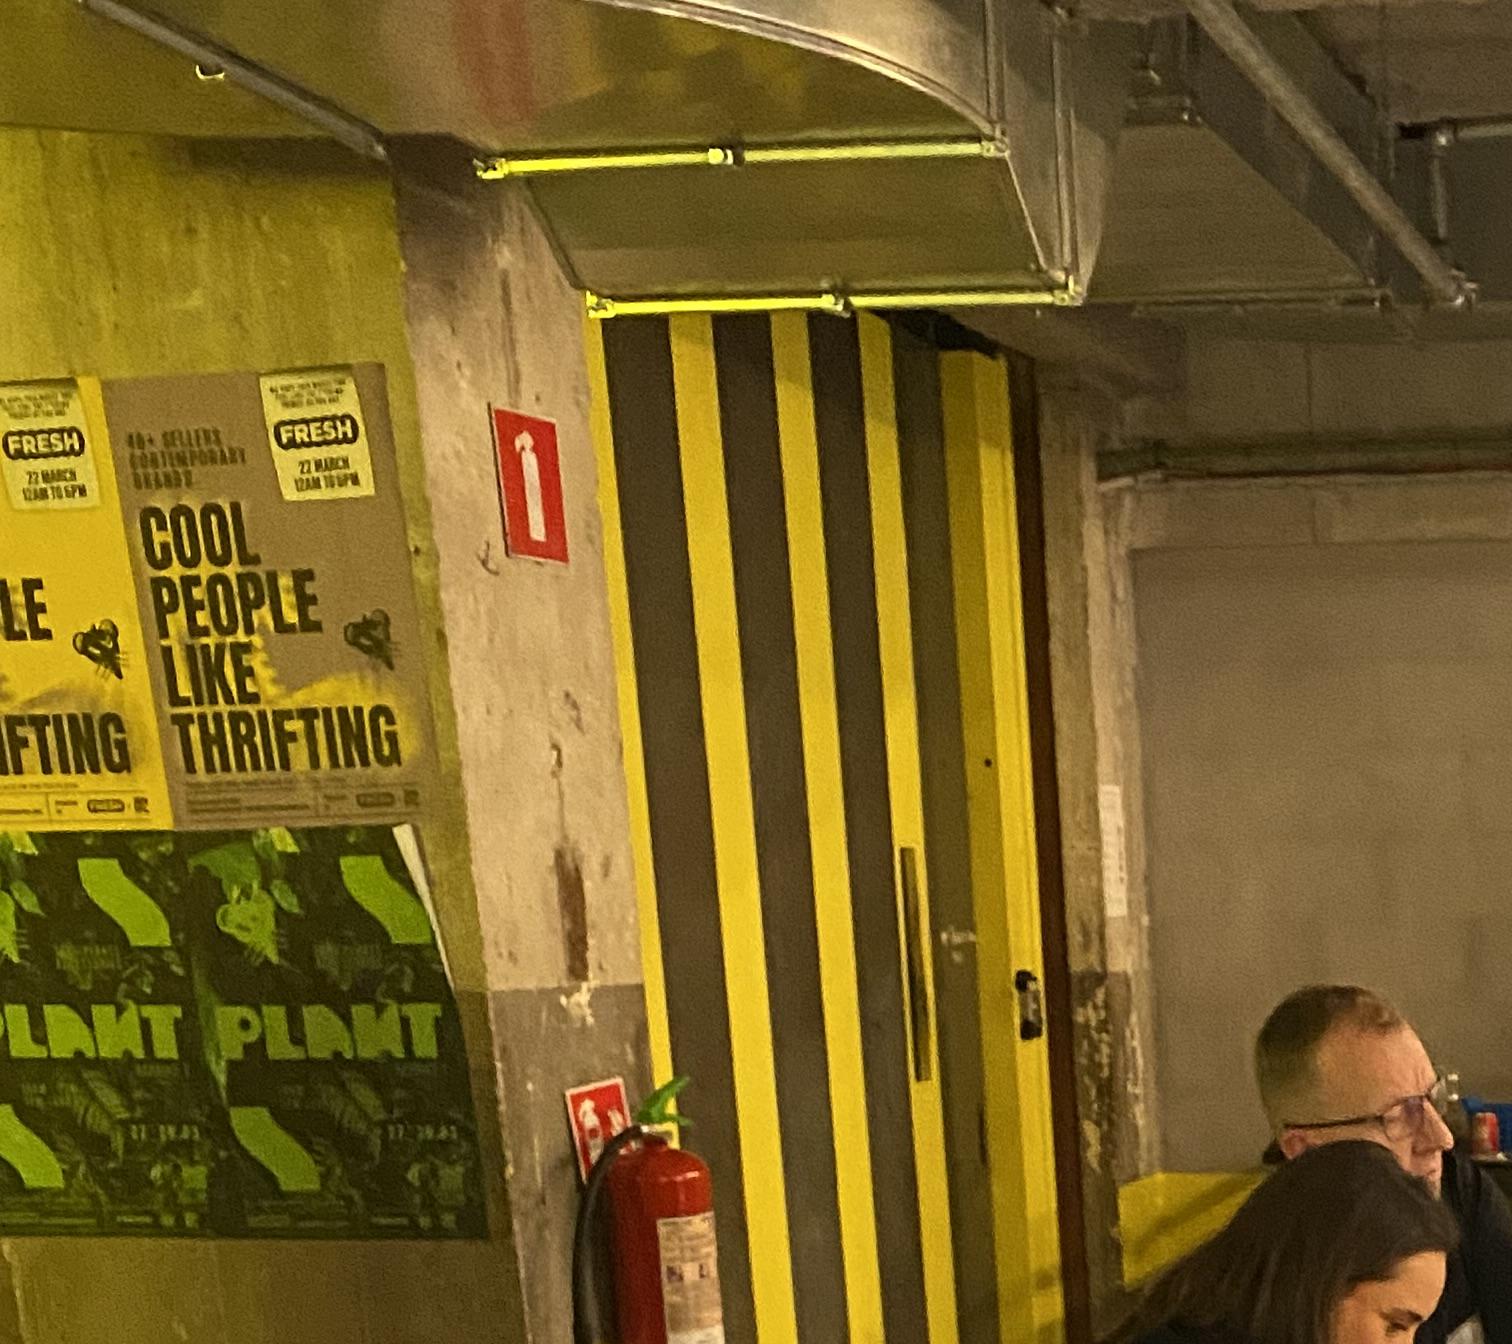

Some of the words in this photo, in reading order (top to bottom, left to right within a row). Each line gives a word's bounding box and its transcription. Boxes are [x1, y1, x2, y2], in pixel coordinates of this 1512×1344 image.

[8, 432, 80, 456] FRESH
[281, 419, 353, 444] FRESH
[314, 457, 350, 472] MARCH
[140, 501, 262, 570] COOL
[150, 568, 323, 641] PEOPLE
[160, 640, 262, 707] LIKE
[171, 704, 403, 775] THRIFTING
[0, 1004, 182, 1059] LANT
[217, 1003, 442, 1059] PLANT
